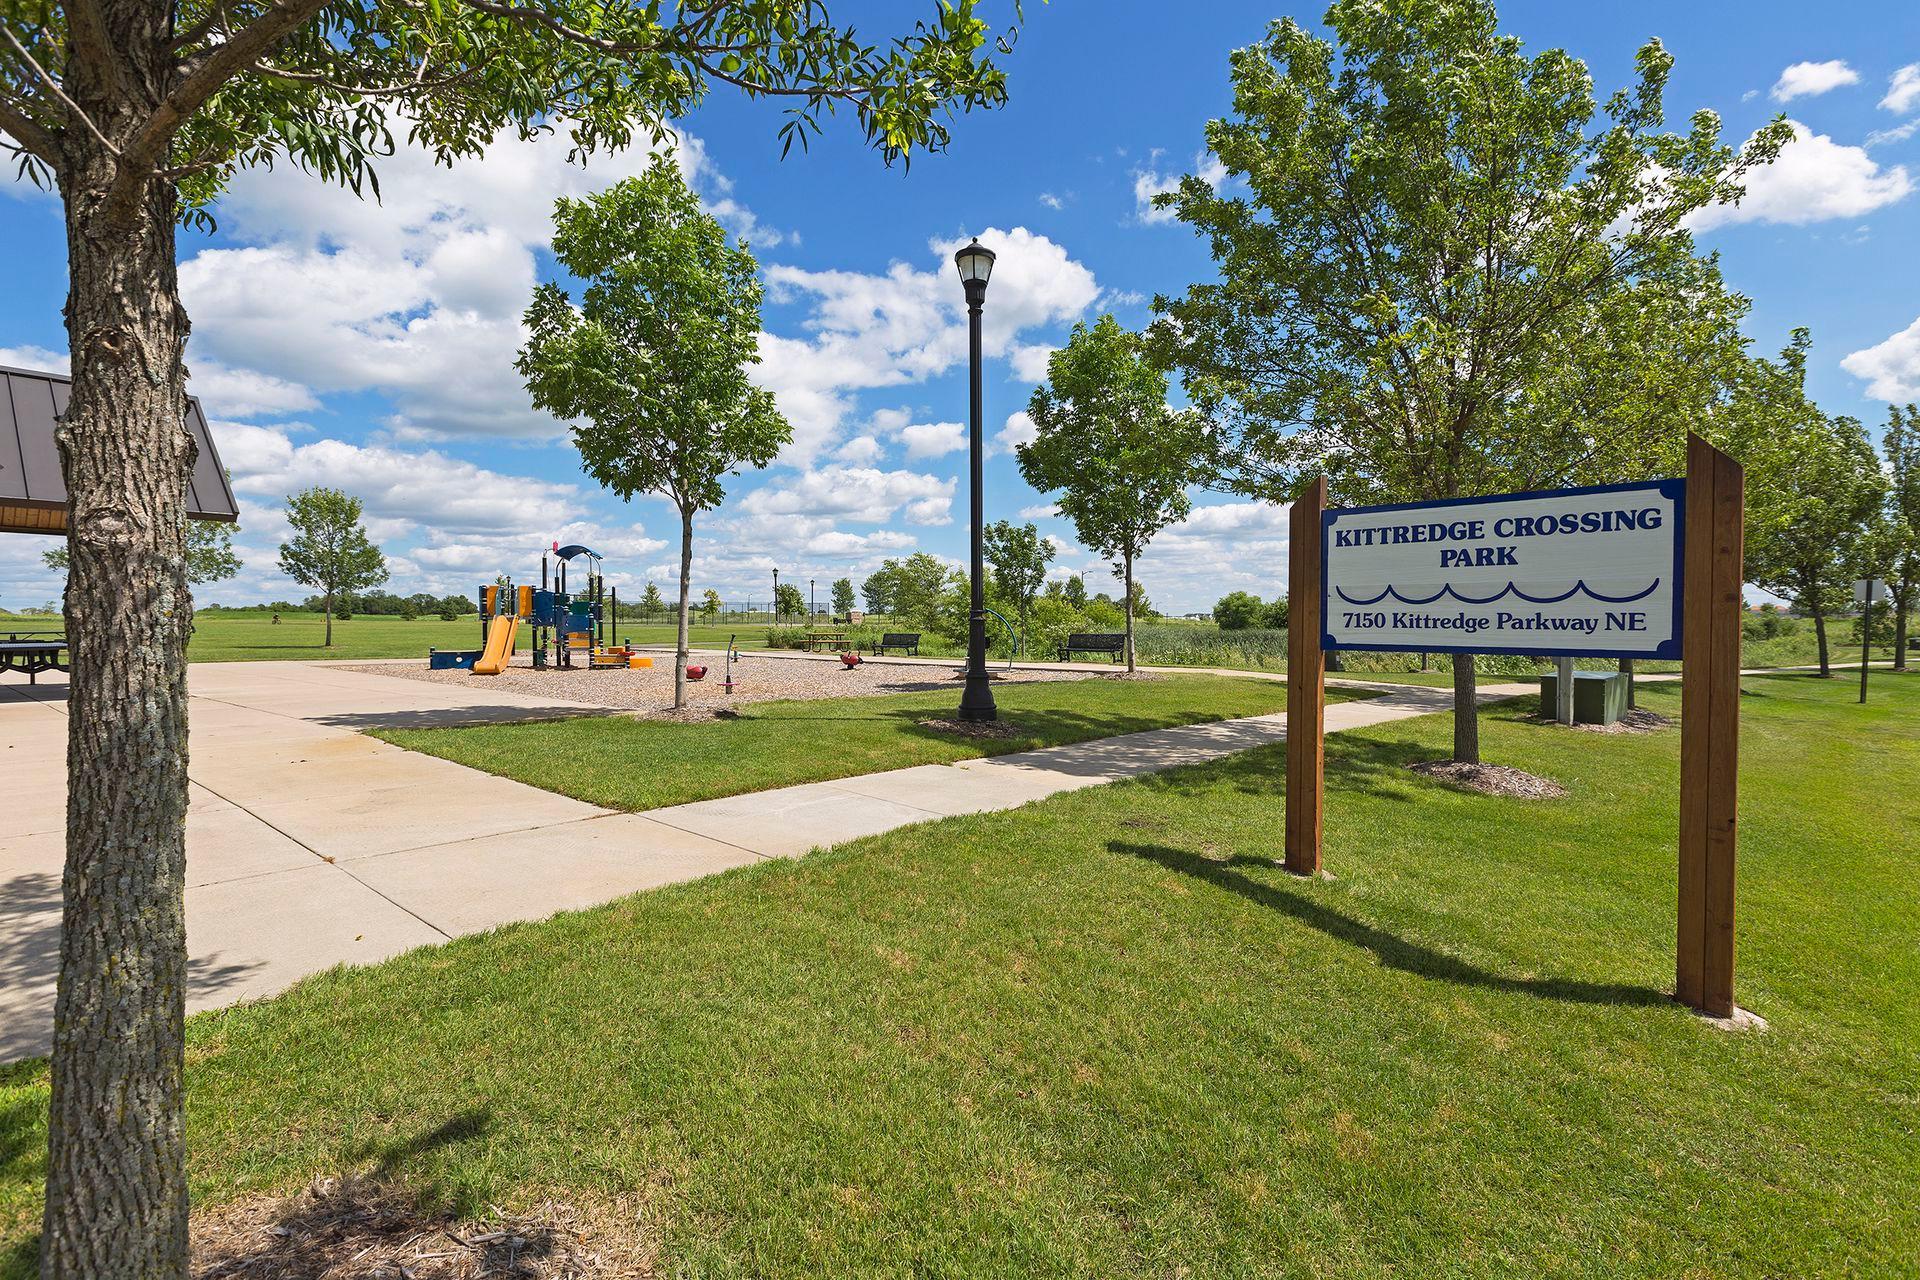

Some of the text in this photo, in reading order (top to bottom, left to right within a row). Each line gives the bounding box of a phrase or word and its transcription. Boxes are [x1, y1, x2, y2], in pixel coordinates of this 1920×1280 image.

[1335, 508, 1662, 547] KITTREDGE CROSSING
[1440, 546, 1519, 568] PARK
[1342, 612, 1647, 635] 7150 Kittredge Parkway NE
